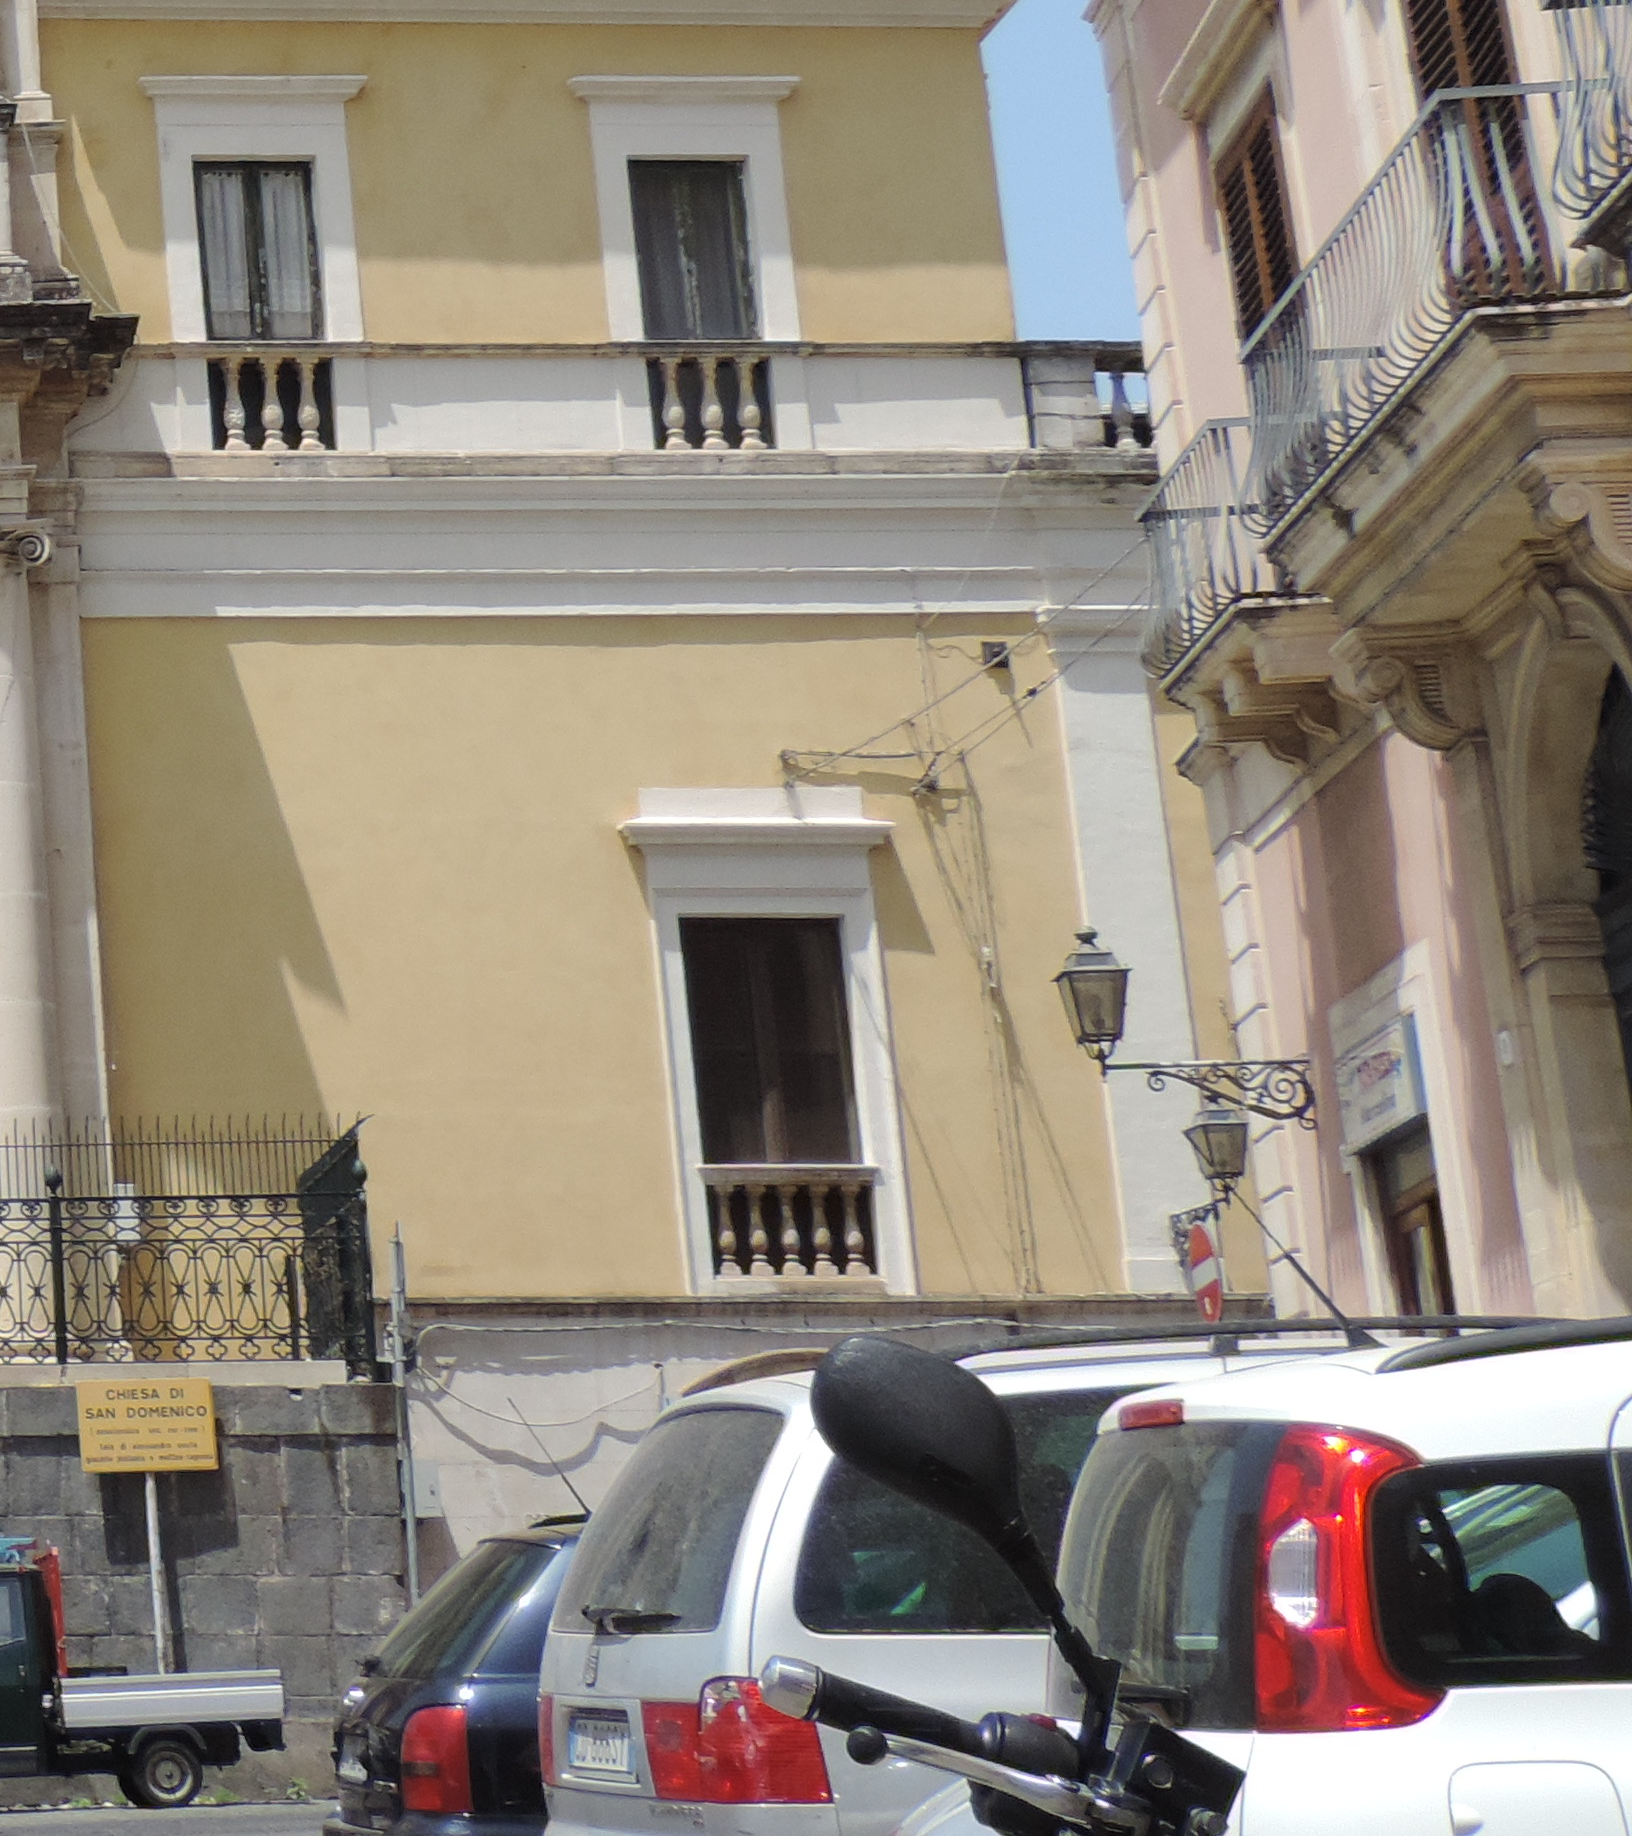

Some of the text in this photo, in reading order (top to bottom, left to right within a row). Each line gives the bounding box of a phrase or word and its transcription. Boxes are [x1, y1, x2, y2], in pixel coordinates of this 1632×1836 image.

[105, 1386, 185, 1401] CHIESA DI
[84, 1404, 209, 1420] SAN DOMENICO
